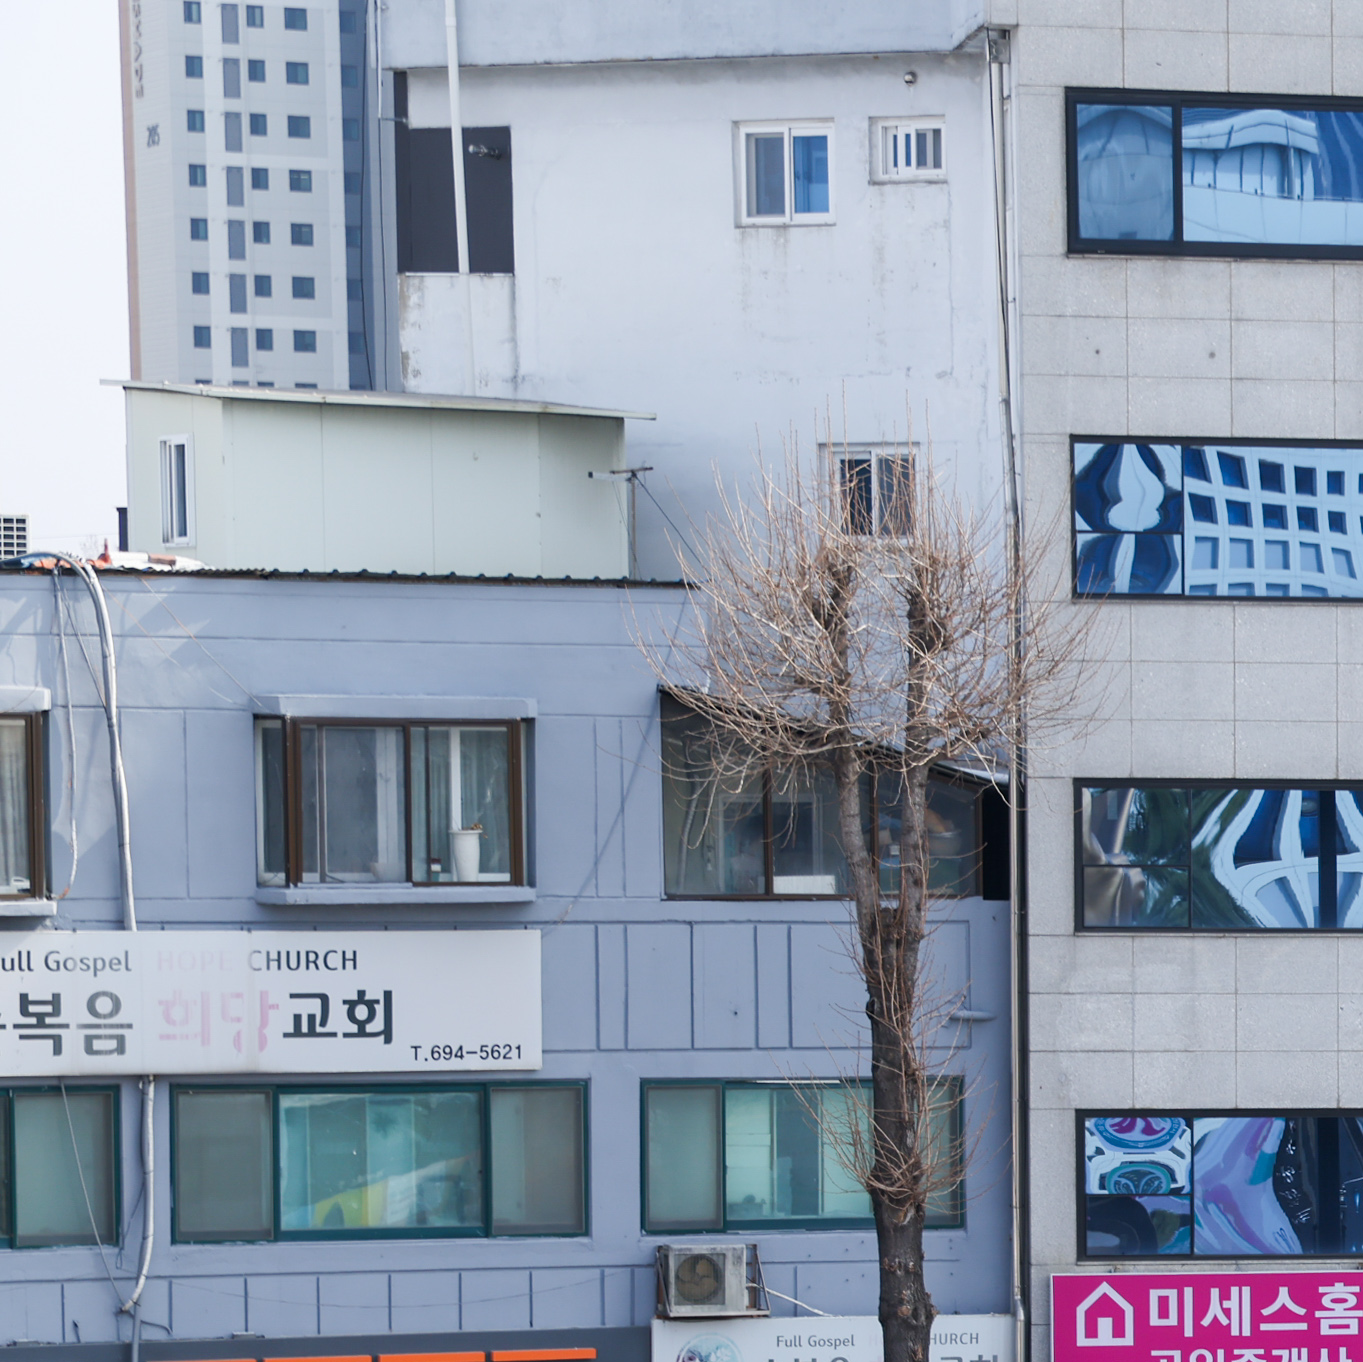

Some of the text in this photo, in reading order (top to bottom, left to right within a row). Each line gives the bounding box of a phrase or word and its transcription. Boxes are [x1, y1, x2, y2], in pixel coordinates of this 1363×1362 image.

[0, 950, 33, 972] ull
[44, 950, 132, 976] Gospel
[248, 950, 358, 971] CHURCH
[0, 990, 134, 1058] 복음
[776, 1332, 980, 1351] Full Gospel HURCH
